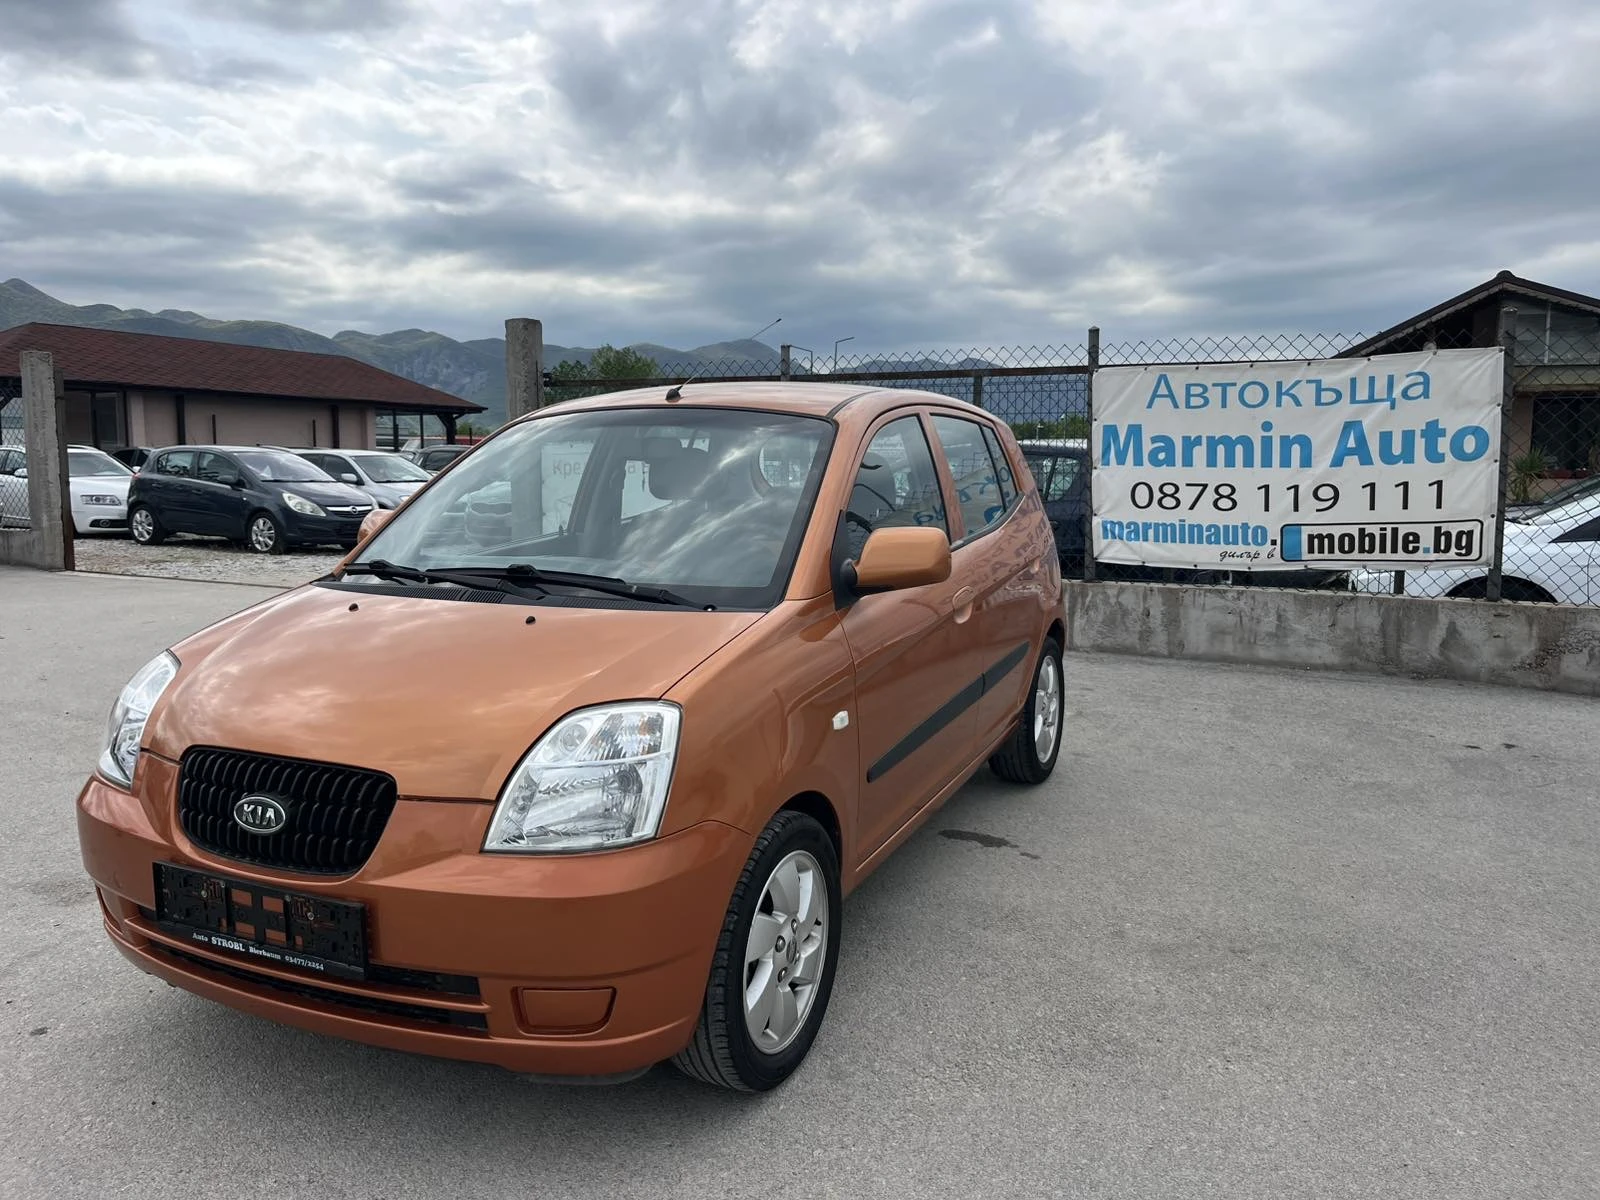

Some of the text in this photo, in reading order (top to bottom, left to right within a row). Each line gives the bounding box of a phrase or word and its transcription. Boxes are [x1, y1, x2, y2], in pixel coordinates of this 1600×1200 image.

[1146, 370, 1431, 410] Автокъща
[1101, 418, 1491, 469] Marmin Auto
[1130, 479, 1444, 513] 0878 119 111
[1219, 550, 1260, 562] дилър
[1306, 525, 1475, 557] mobile.bg
[242, 803, 276, 827] KIA
[192, 932, 209, 942] Auto
[211, 936, 246, 952] STROBL
[248, 946, 281, 960] Bierbaum
